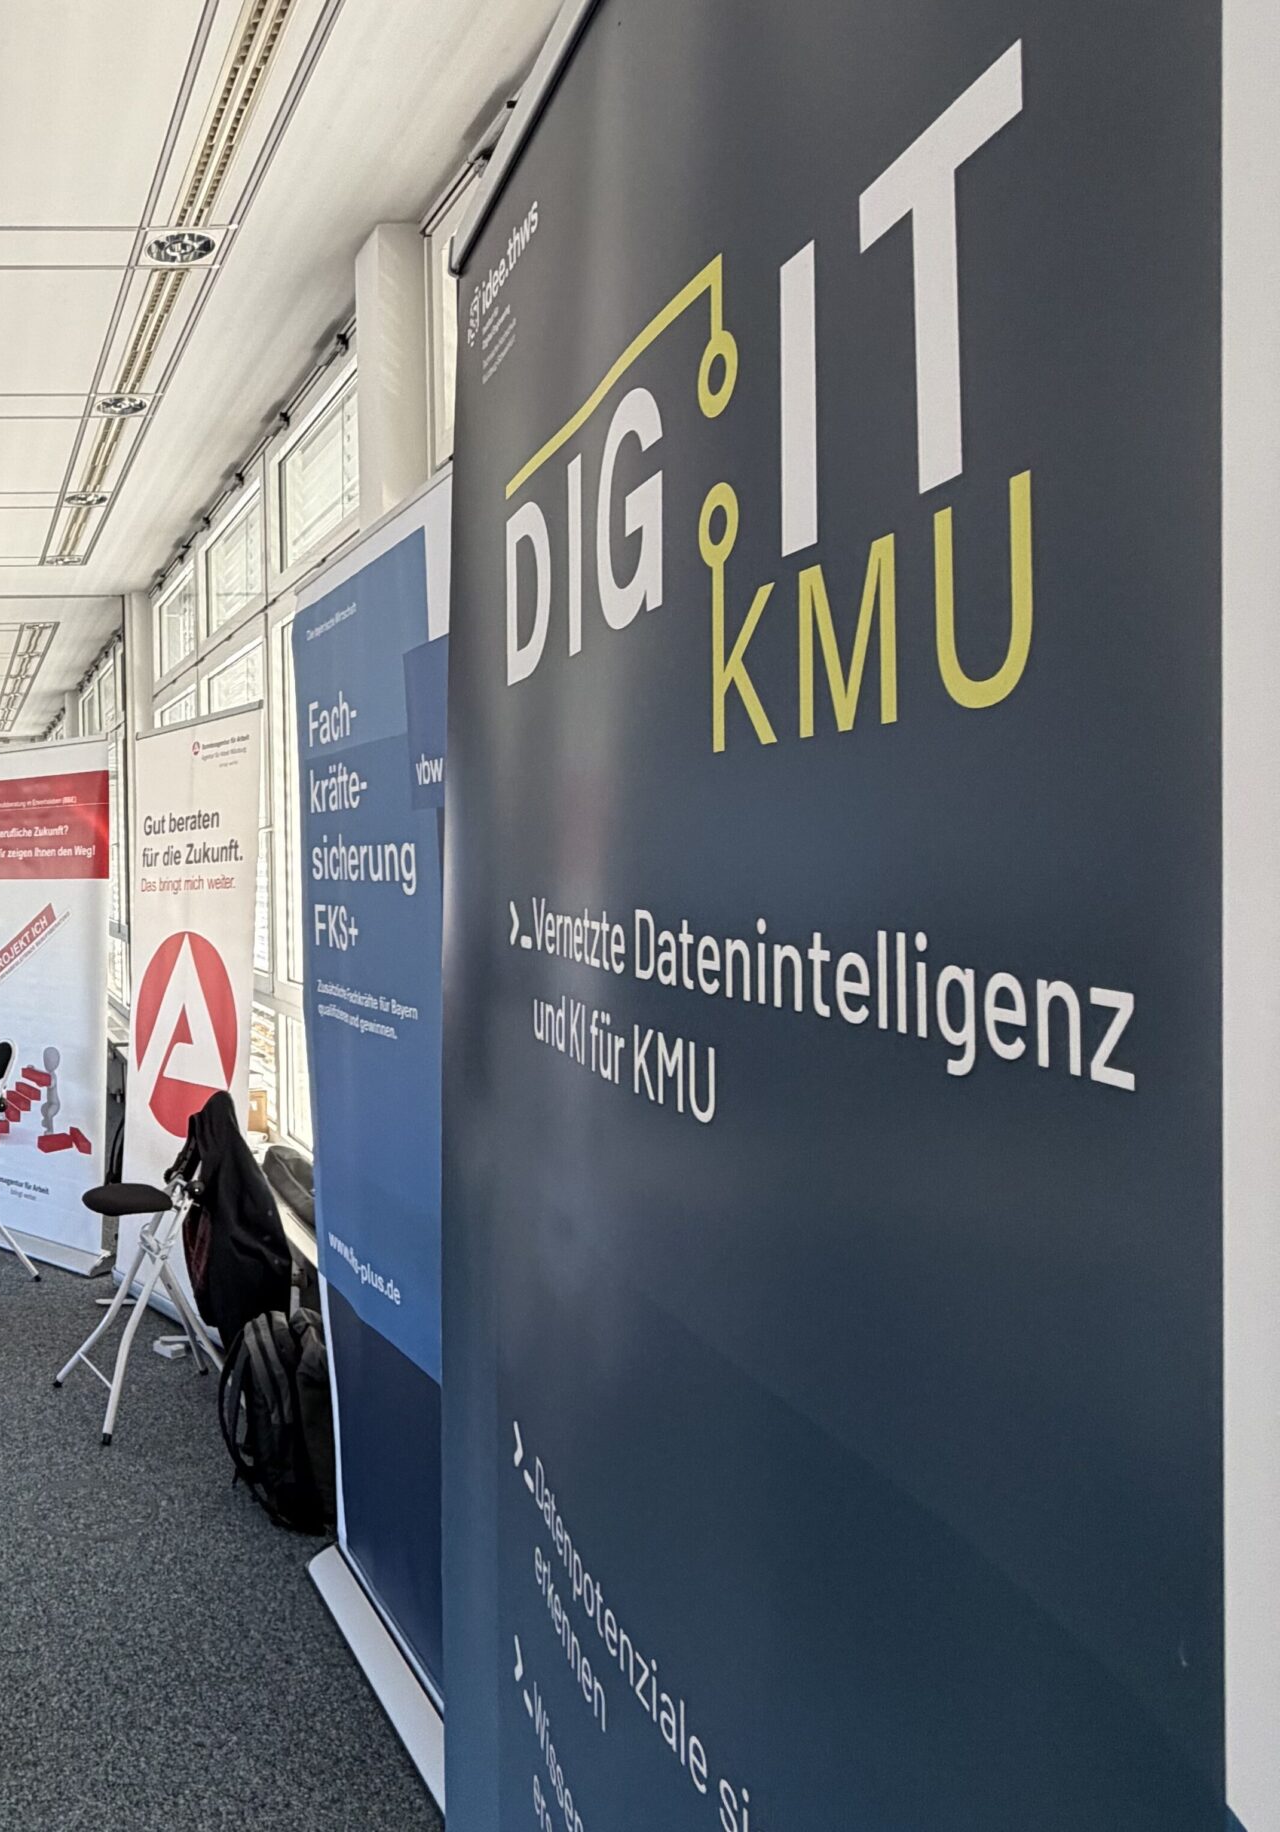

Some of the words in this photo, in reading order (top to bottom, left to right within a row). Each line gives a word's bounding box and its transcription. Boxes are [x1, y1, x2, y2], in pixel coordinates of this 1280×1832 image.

[482, 200, 539, 315] idee.thws
[712, 470, 1033, 753] KMU
[308, 690, 357, 747] Fach-
[310, 762, 367, 813] kräfte-
[416, 753, 444, 785] vbw
[34, 825, 69, 837] Zukunft?
[144, 815, 166, 836] Gut
[169, 809, 220, 833] beraten
[7, 848, 32, 860] zeigen
[34, 846, 56, 857] Ihnen
[57, 846, 72, 856] den
[74, 844, 96, 858] Weg!
[142, 847, 160, 867] für
[162, 845, 182, 866] die
[185, 838, 243, 864] Zukunft.
[312, 834, 417, 896] sicherung
[141, 878, 157, 892] Das
[159, 877, 182, 895] bringt
[184, 875, 204, 890] mich
[207, 874, 236, 890] weiter.
[31, 915, 48, 937] ICH
[314, 903, 359, 951] FKS+
[391, 998, 418, 1020] Bayern
[532, 897, 626, 974] Vernetzte
[634, 909, 1135, 1091] Datenintelligenz
[533, 995, 566, 1053] und
[569, 999, 586, 1065] KI
[590, 1010, 625, 1084] für
[633, 1024, 716, 1123] KMU
[534, 1546, 606, 1732] erkennen
[535, 1456, 708, 1794] Datenpotenziale
